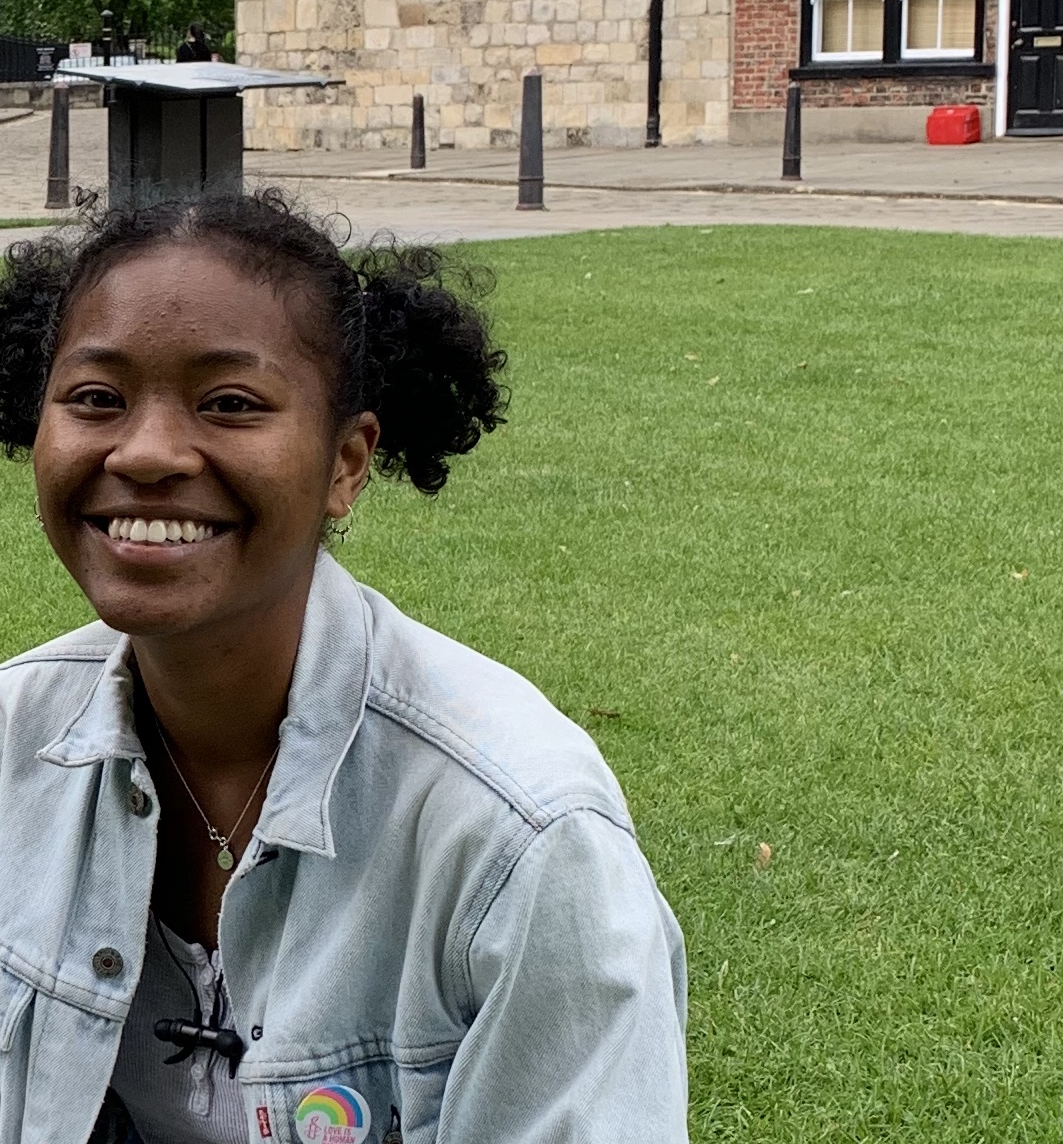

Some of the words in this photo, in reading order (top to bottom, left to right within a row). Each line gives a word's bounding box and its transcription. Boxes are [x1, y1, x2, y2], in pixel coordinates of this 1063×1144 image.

[324, 1125, 342, 1135] LOVE
[344, 1127, 352, 1136] IS
[329, 1135, 356, 1144] HUMAN
